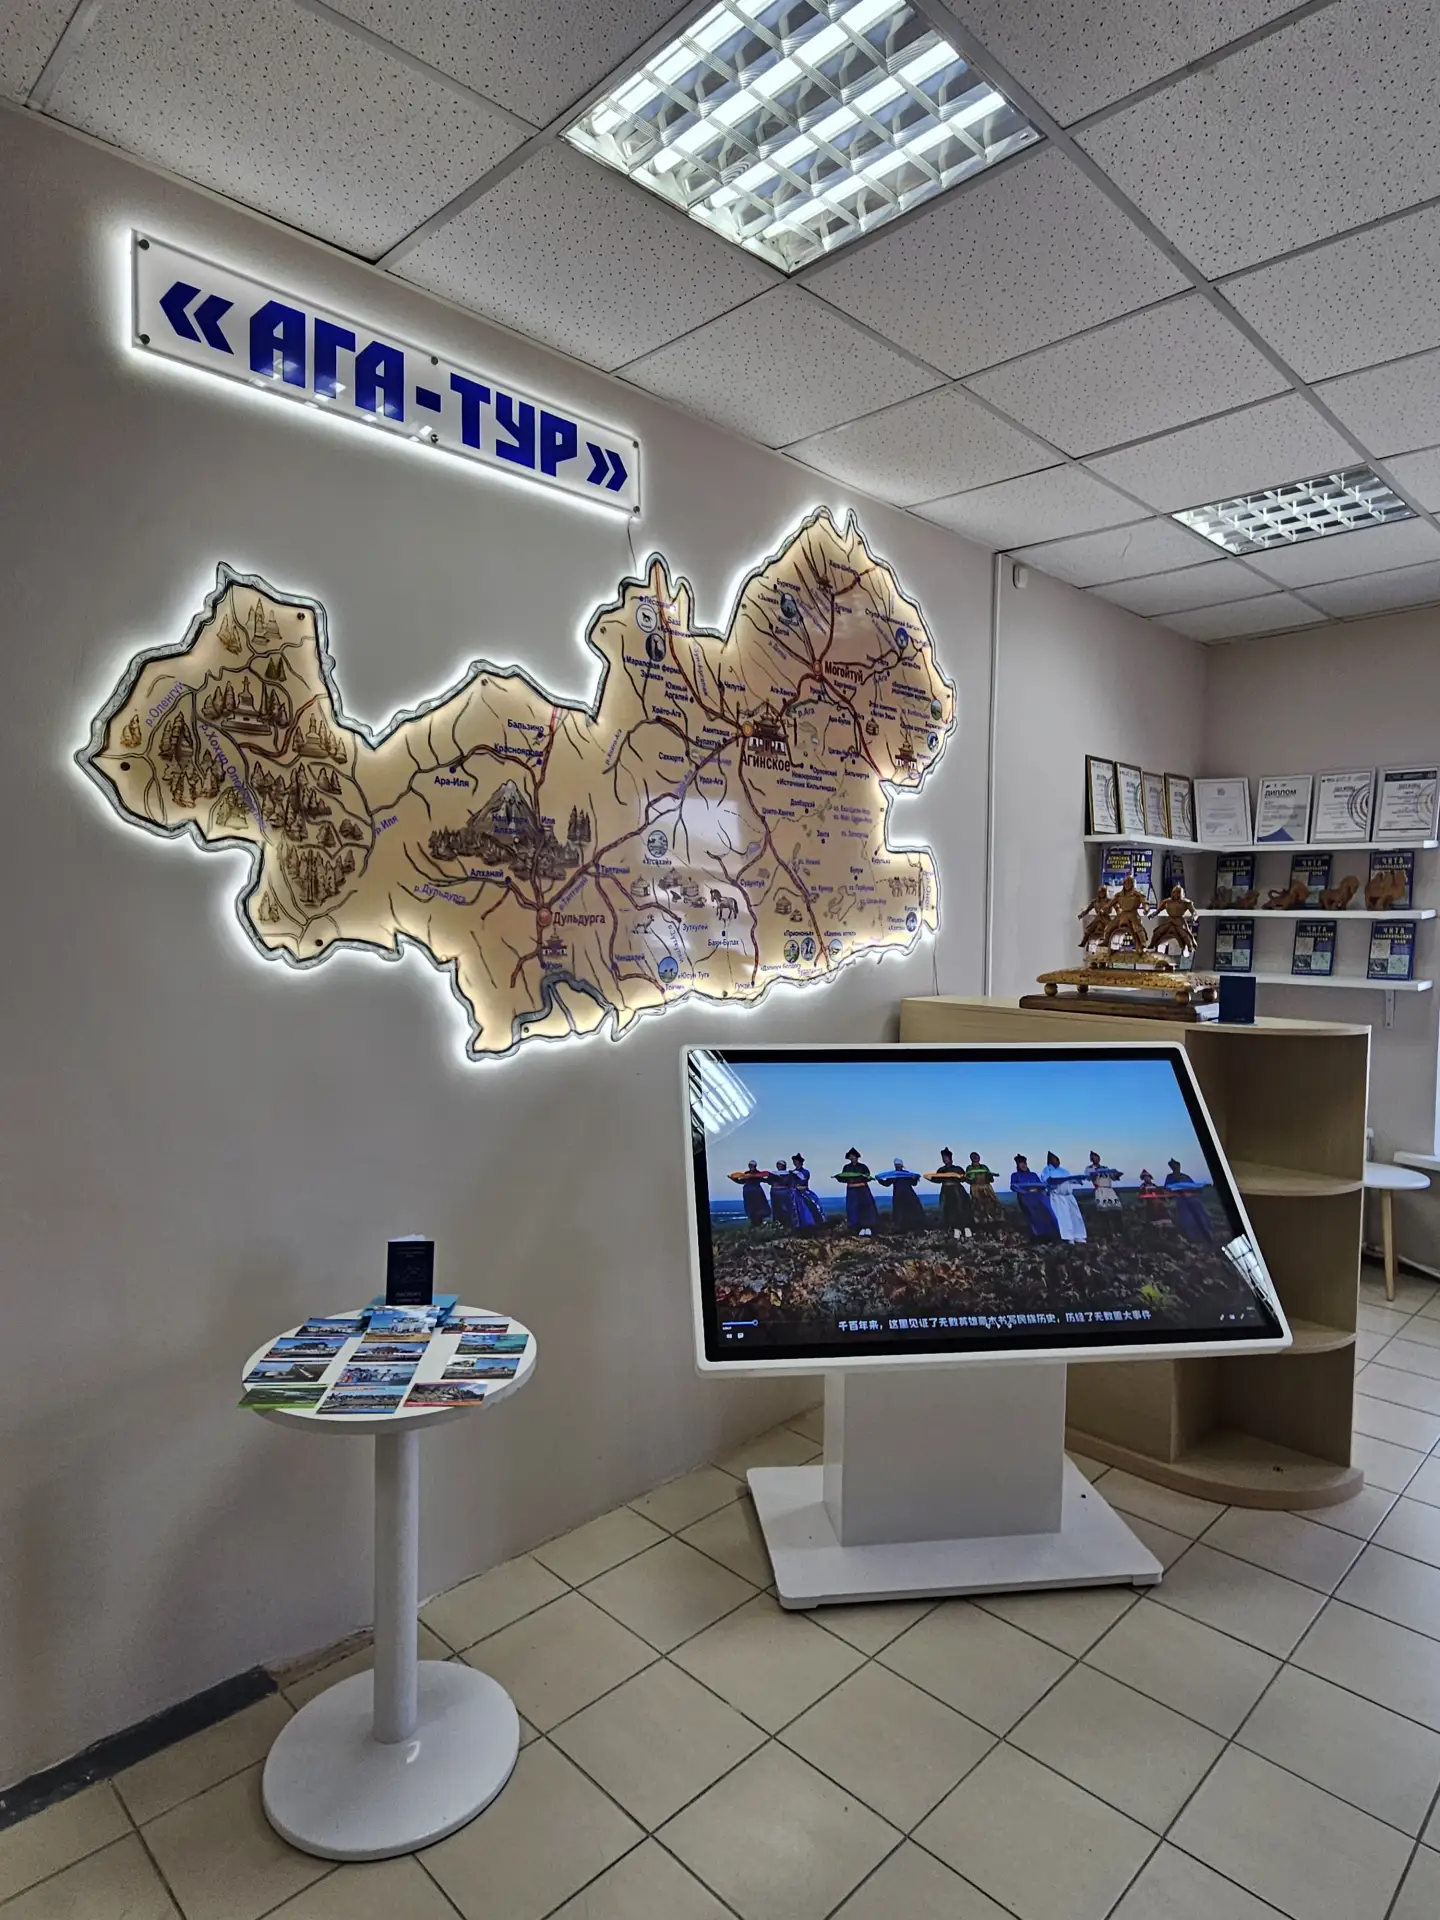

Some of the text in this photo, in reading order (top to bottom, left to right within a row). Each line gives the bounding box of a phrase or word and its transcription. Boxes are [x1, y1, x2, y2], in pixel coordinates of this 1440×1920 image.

[825, 661, 864, 684] Могойтуй
[434, 776, 469, 788] Ара-Иля
[470, 868, 504, 878] Алханай
[553, 912, 606, 927] Дульдурга
